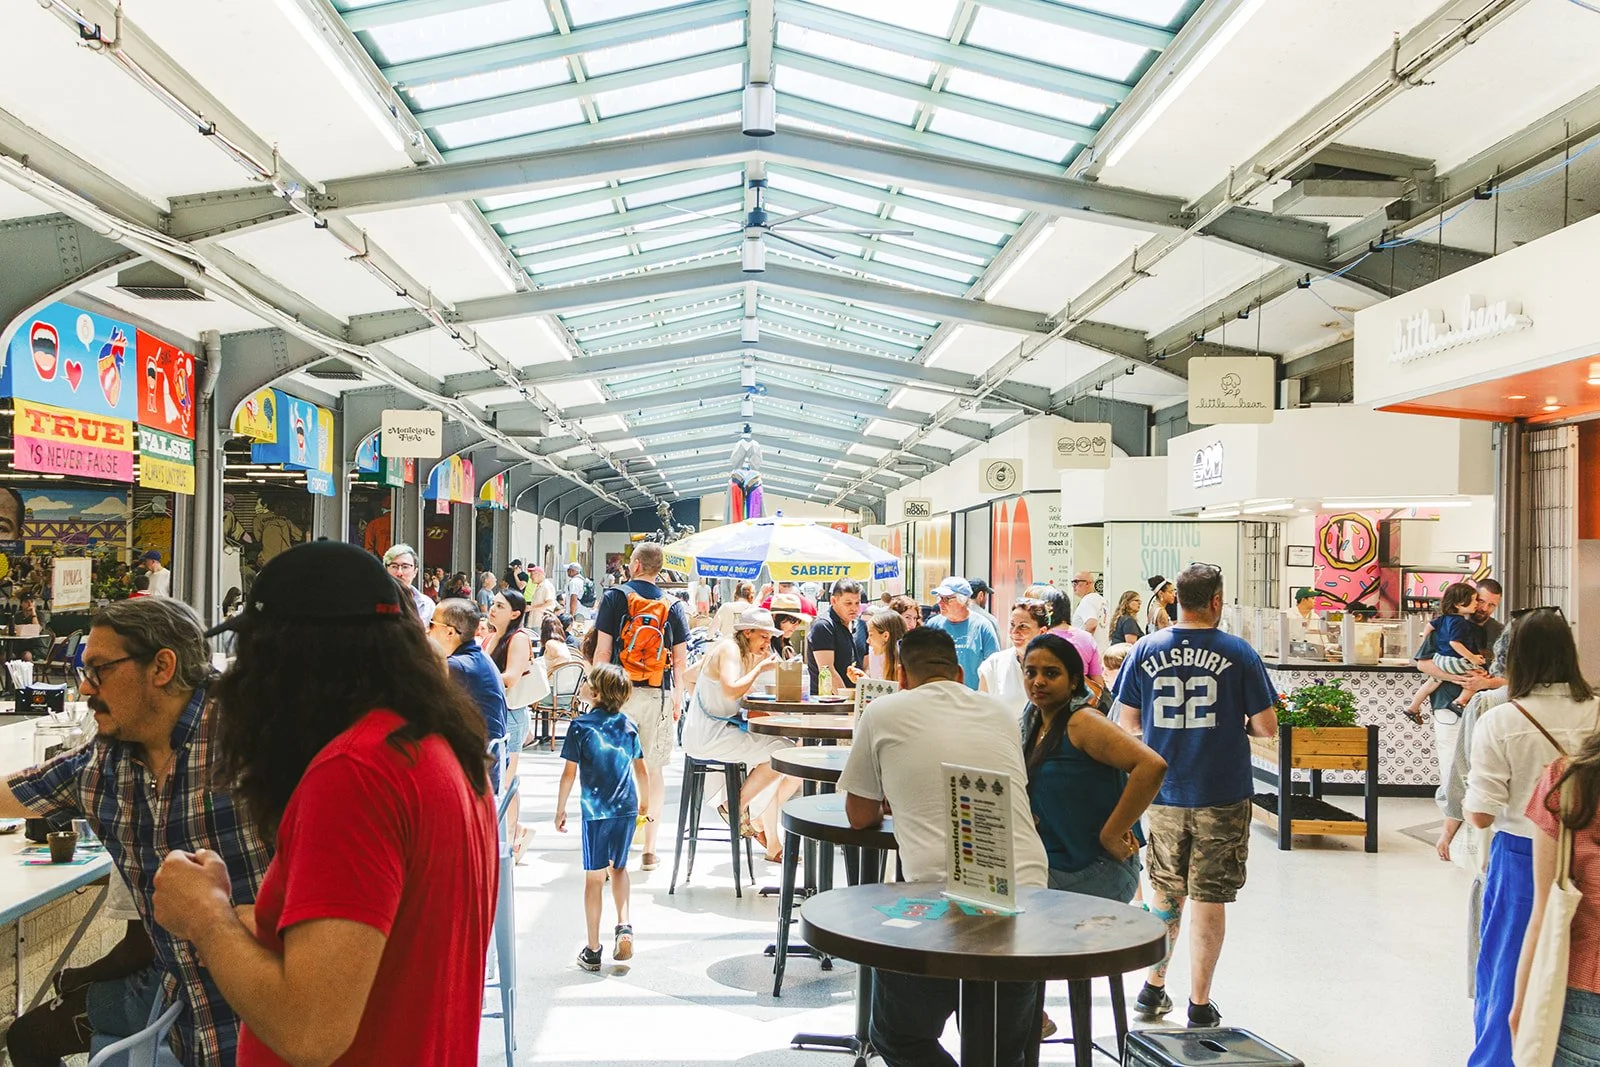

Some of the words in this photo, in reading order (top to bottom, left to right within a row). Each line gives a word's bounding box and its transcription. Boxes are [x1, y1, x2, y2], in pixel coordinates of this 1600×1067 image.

[1196, 398, 1225, 408] little
[1239, 398, 1267, 408] bear
[24, 408, 125, 445] TRUE
[30, 444, 43, 465] IS
[47, 447, 84, 469] NEVER
[87, 452, 118, 474] FALSE
[139, 430, 191, 461] FALSE
[906, 507, 928, 515] Room
[1048, 505, 1057, 513] So
[1141, 522, 1201, 547] COMING
[1048, 547, 1061, 557] right
[1140, 548, 1181, 582] SOON
[734, 565, 748, 574] ROLL
[790, 565, 851, 576] SABRETT
[1141, 647, 1233, 678] ELLSBURY
[1153, 676, 1218, 729] 22
[950, 776, 958, 818] Events
[951, 819, 961, 882] Upcoming
